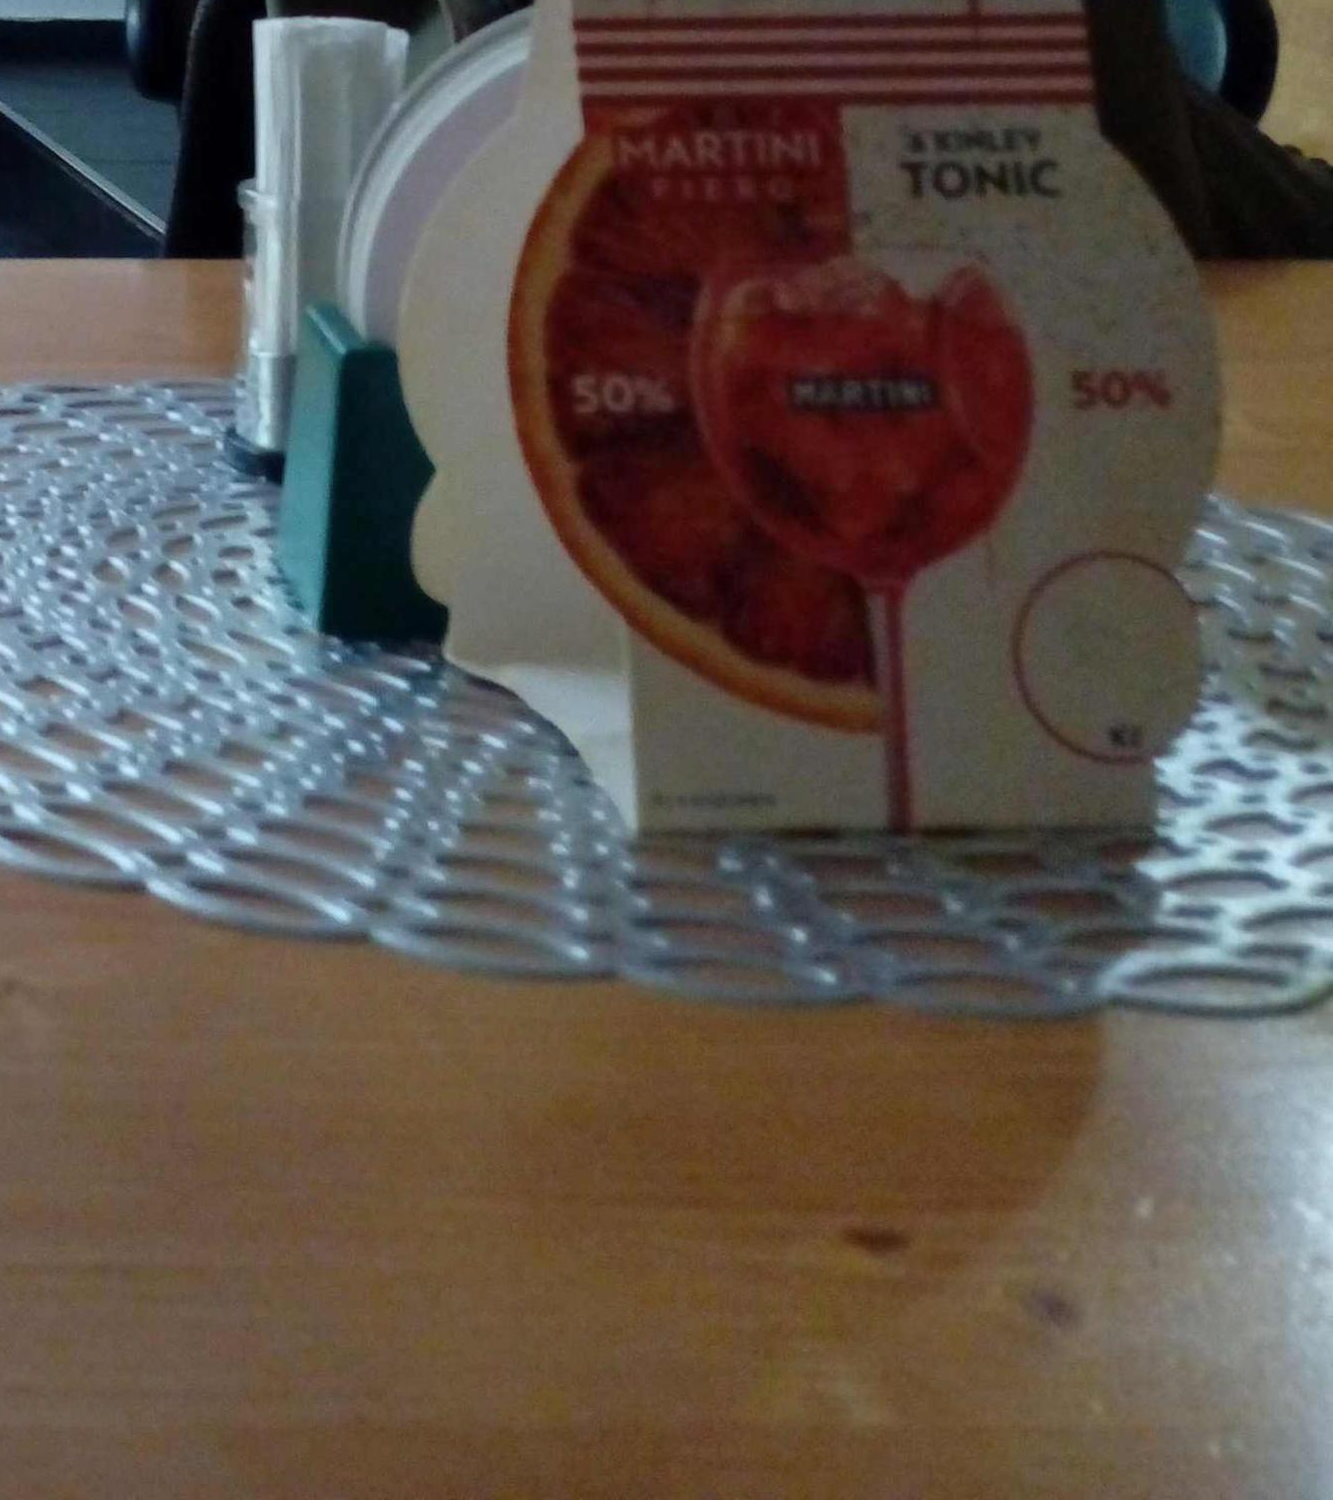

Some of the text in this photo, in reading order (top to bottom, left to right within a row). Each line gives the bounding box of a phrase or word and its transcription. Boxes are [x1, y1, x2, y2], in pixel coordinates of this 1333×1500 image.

[615, 130, 821, 171] MARTINI
[899, 160, 1061, 199] TONIC
[572, 373, 676, 414] 50%
[1071, 368, 1171, 409] 50%
